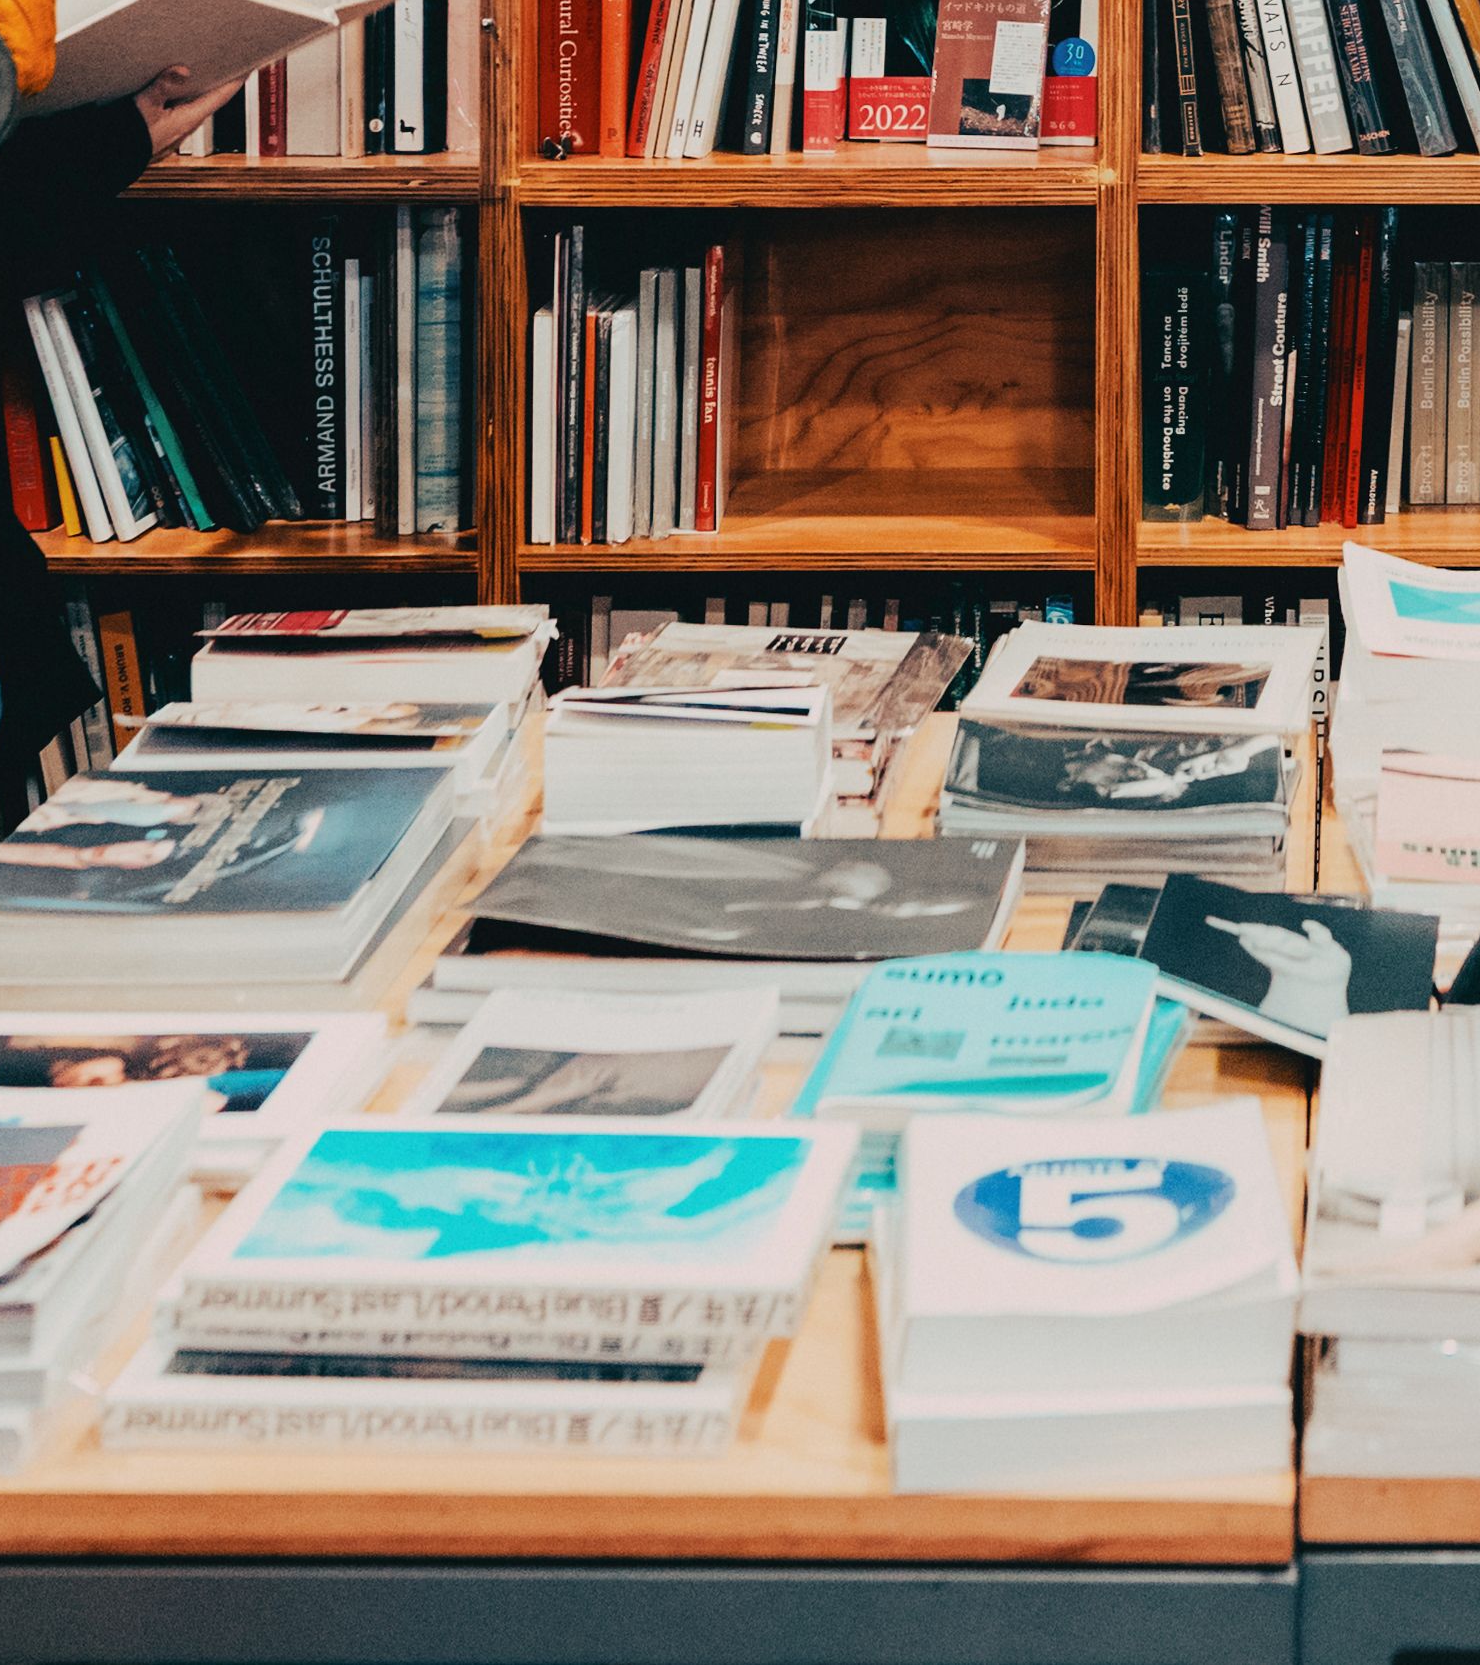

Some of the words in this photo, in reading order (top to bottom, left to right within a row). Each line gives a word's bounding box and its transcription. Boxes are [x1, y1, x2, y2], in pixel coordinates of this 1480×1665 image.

[558, 40, 578, 137] Curiosities
[859, 104, 927, 132] 2022
[1219, 229, 1232, 283] Linder
[312, 237, 333, 387] SCHULTHESS
[706, 357, 716, 398] tennis
[1163, 386, 1172, 399] on
[704, 402, 716, 423] fan
[1162, 403, 1174, 424] the
[1174, 386, 1189, 434] Dancing
[318, 396, 336, 493] ARMAND
[1162, 427, 1174, 469] Double
[1162, 472, 1173, 490] Ice
